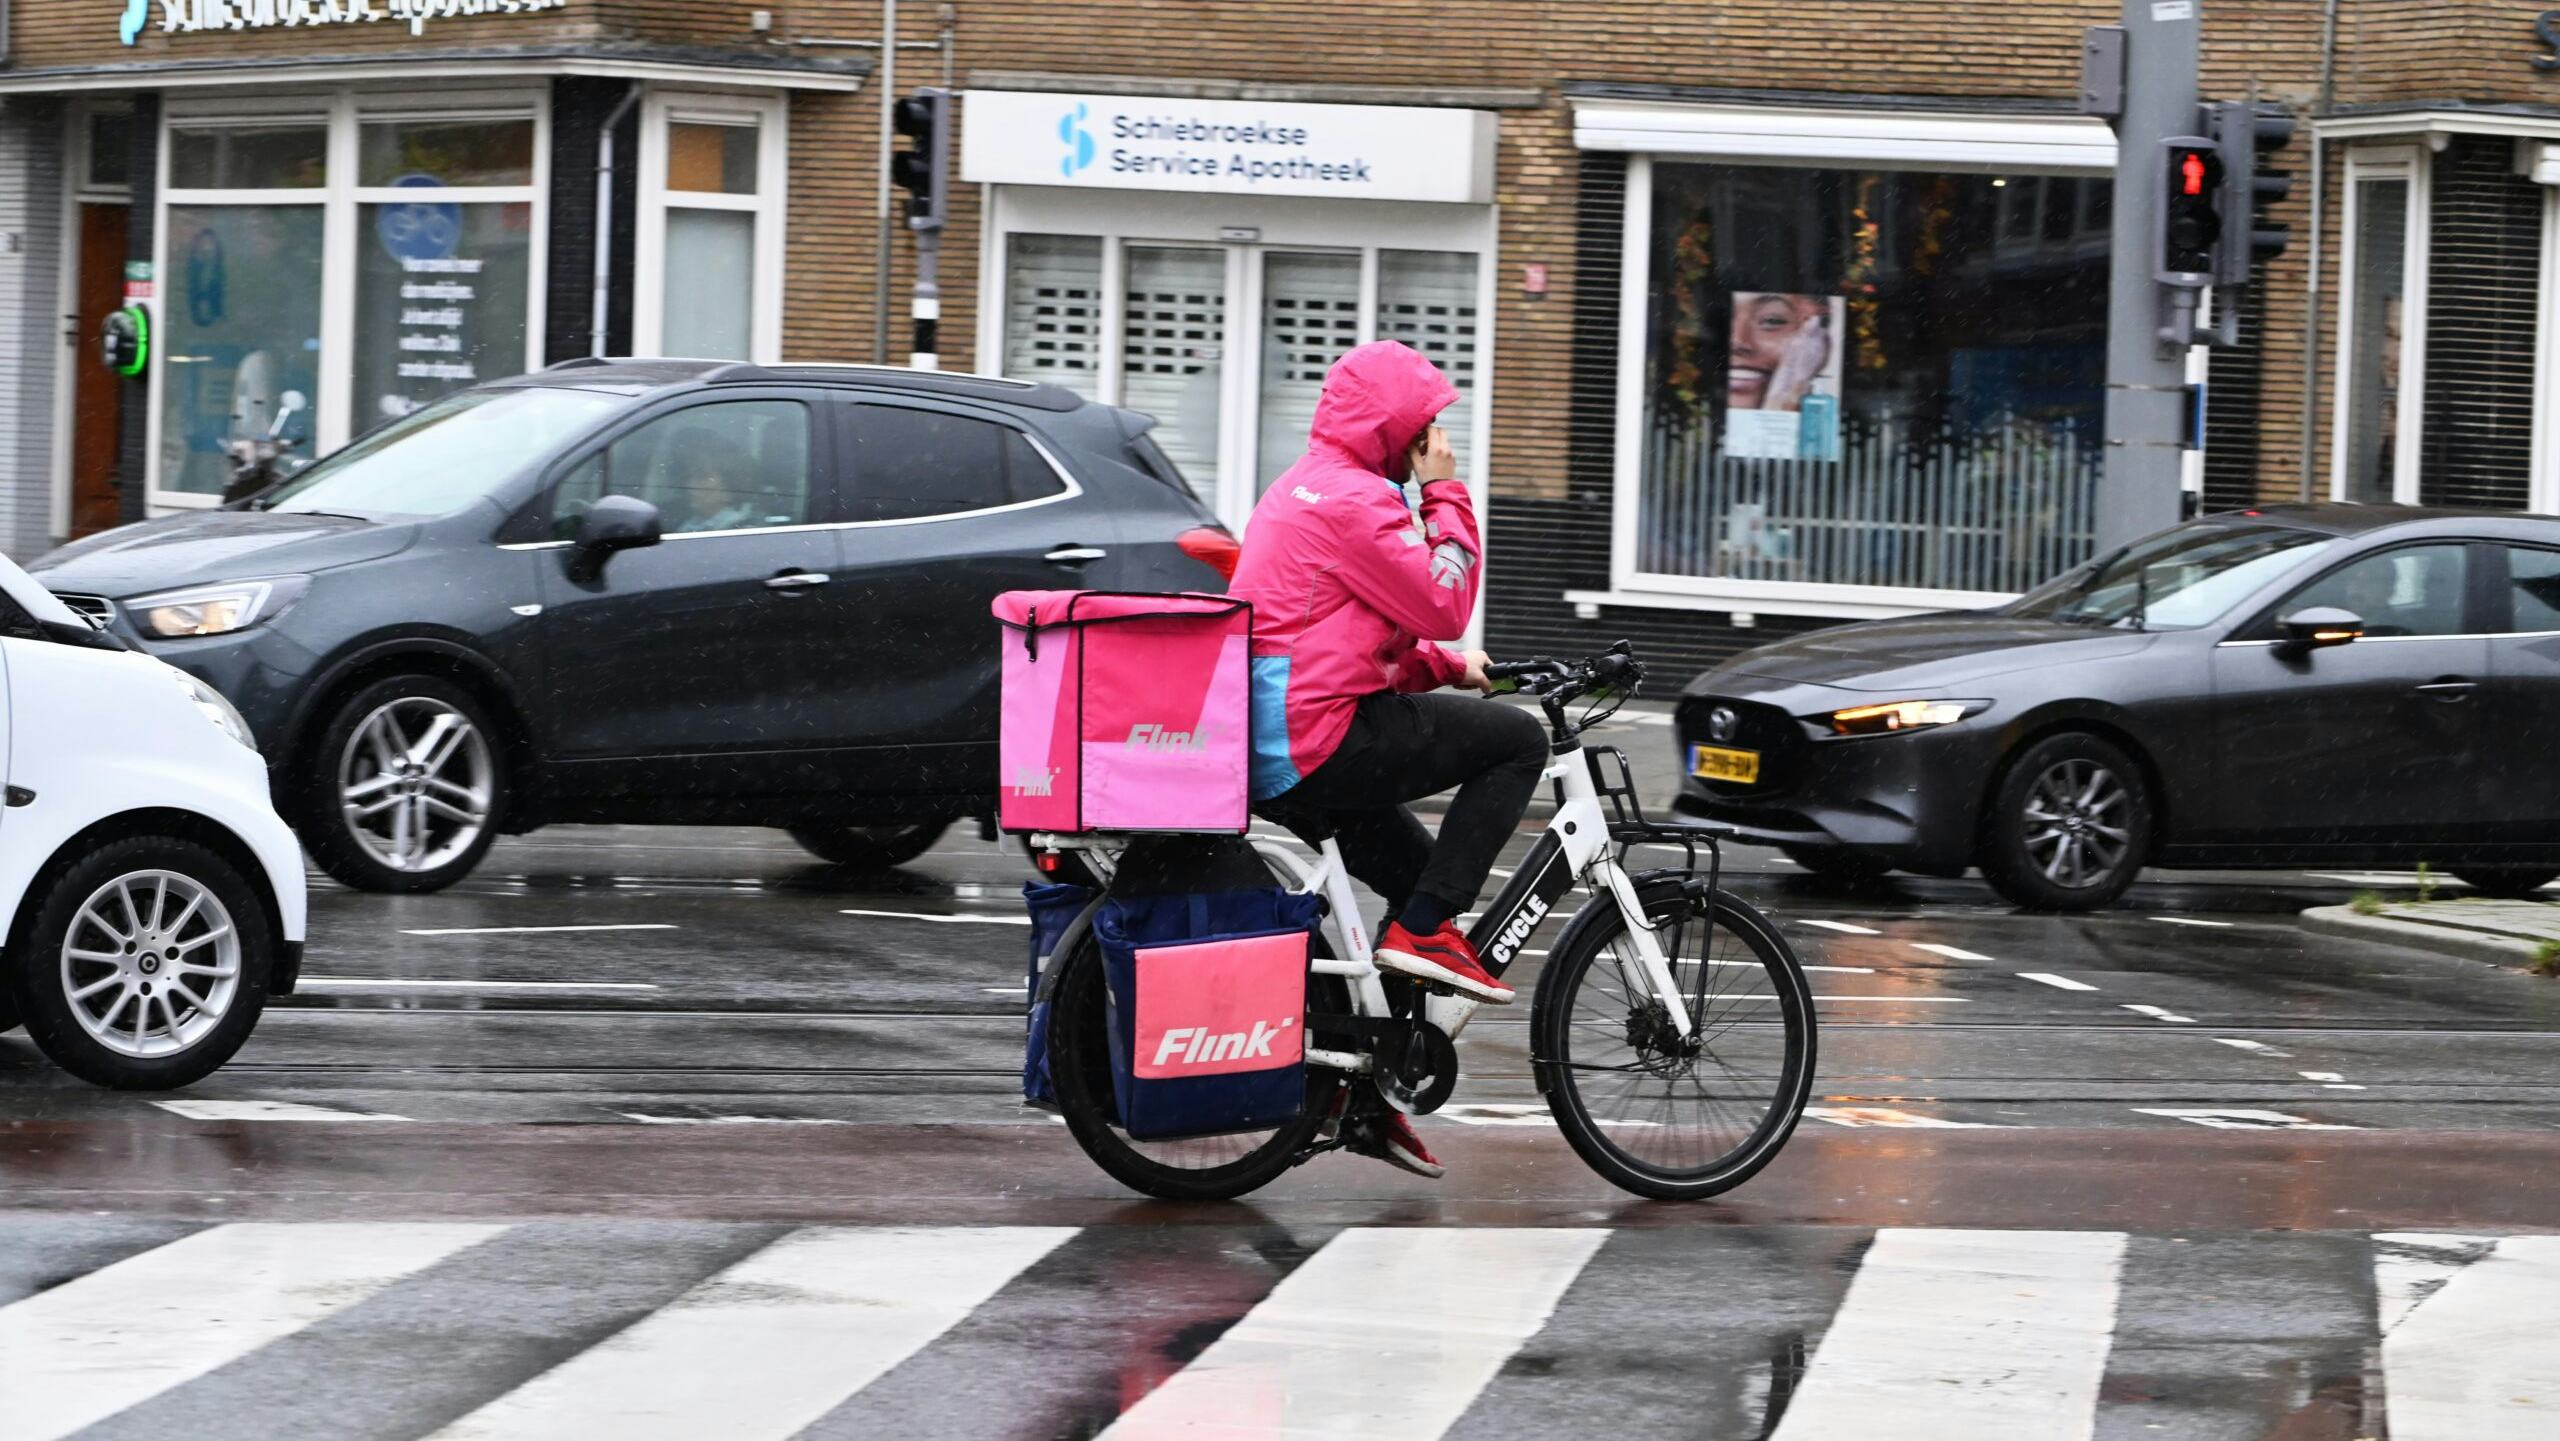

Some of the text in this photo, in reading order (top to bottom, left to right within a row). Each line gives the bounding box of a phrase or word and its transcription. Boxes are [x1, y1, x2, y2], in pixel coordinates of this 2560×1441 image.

[1112, 114, 1308, 146] Schiebroekse
[1110, 148, 1372, 184] Service Apotheek
[1124, 723, 1224, 753] Flink
[1014, 766, 1061, 797] Flink
[1491, 893, 1549, 964] CYCLE
[1152, 1017, 1294, 1066] Flink
